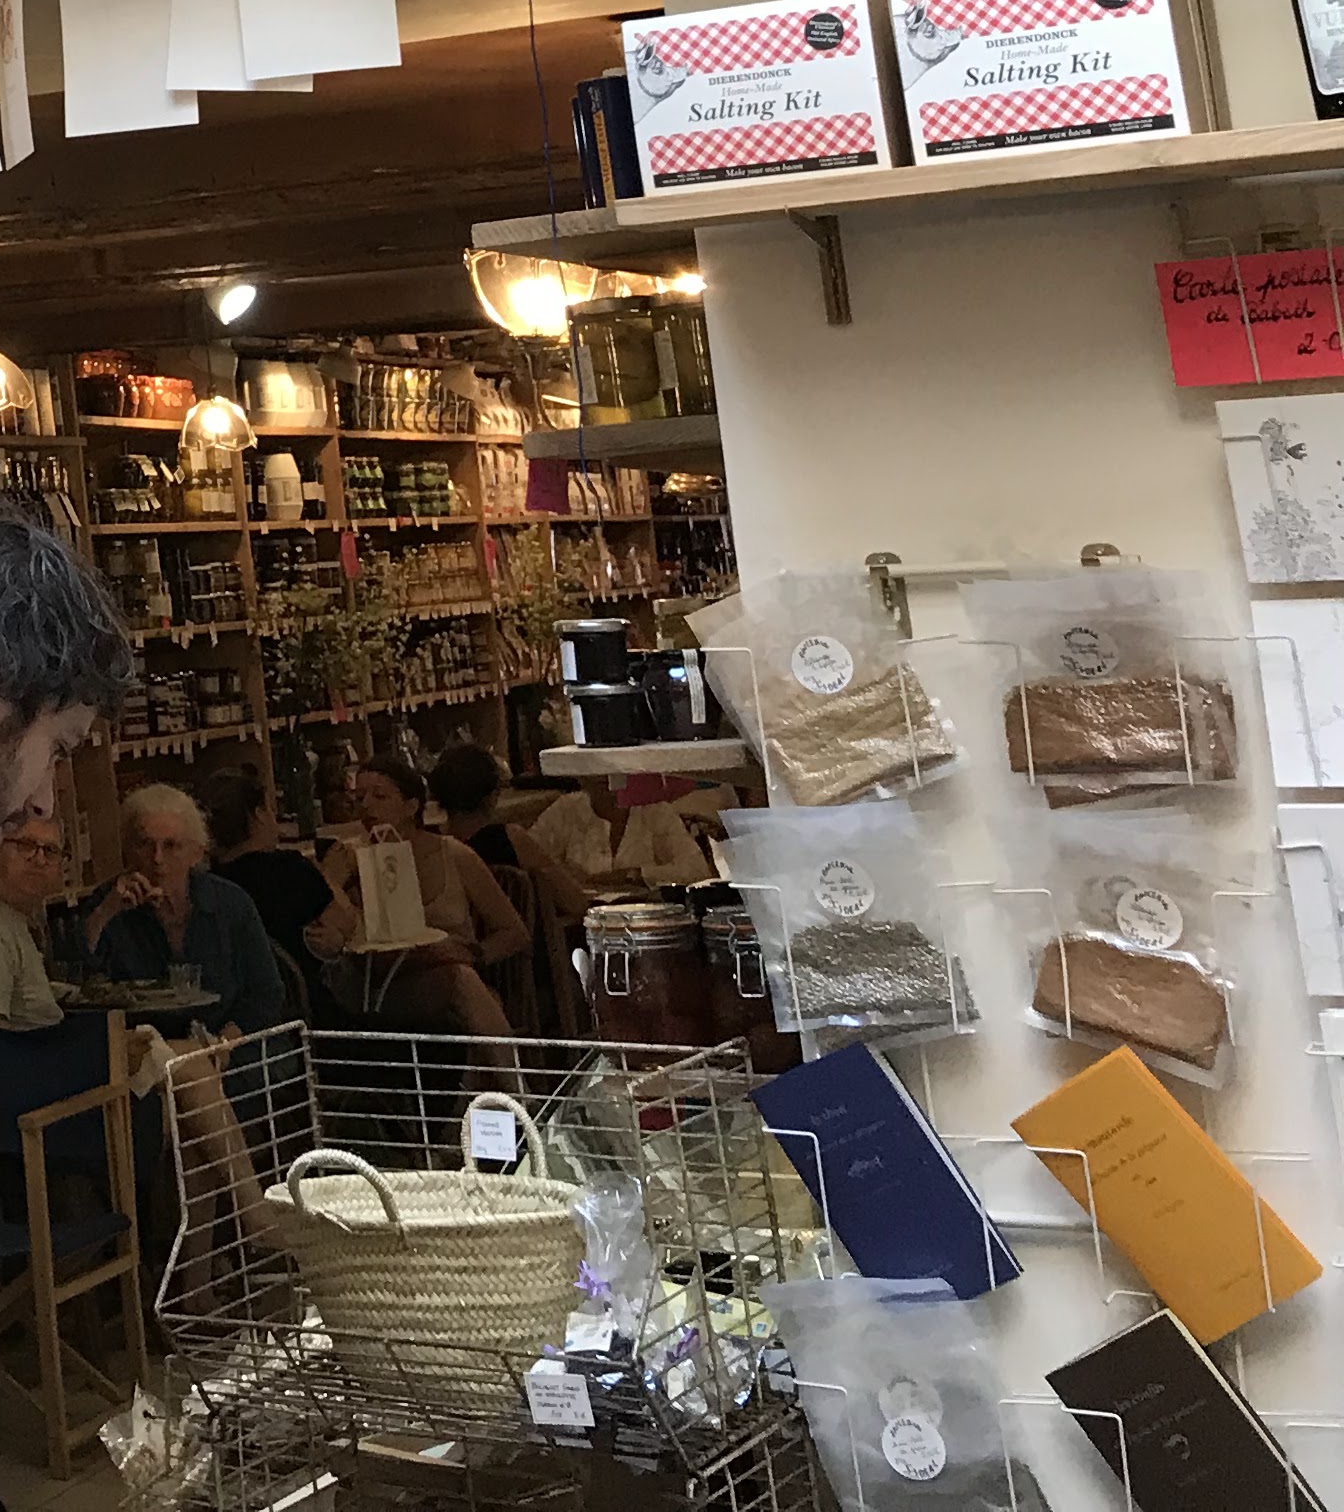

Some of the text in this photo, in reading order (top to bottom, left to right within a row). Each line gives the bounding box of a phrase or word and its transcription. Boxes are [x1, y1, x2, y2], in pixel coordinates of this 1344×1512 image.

[985, 27, 1079, 49] DIERENDONCK
[1000, 42, 1070, 61] Home-Made
[707, 67, 793, 87] DIERENDONCK
[963, 50, 1114, 89] Salting Kit
[720, 81, 783, 97] Home-Made
[687, 88, 823, 123] Salting Kit
[1005, 134, 1029, 146] Make
[724, 166, 746, 178] Make
